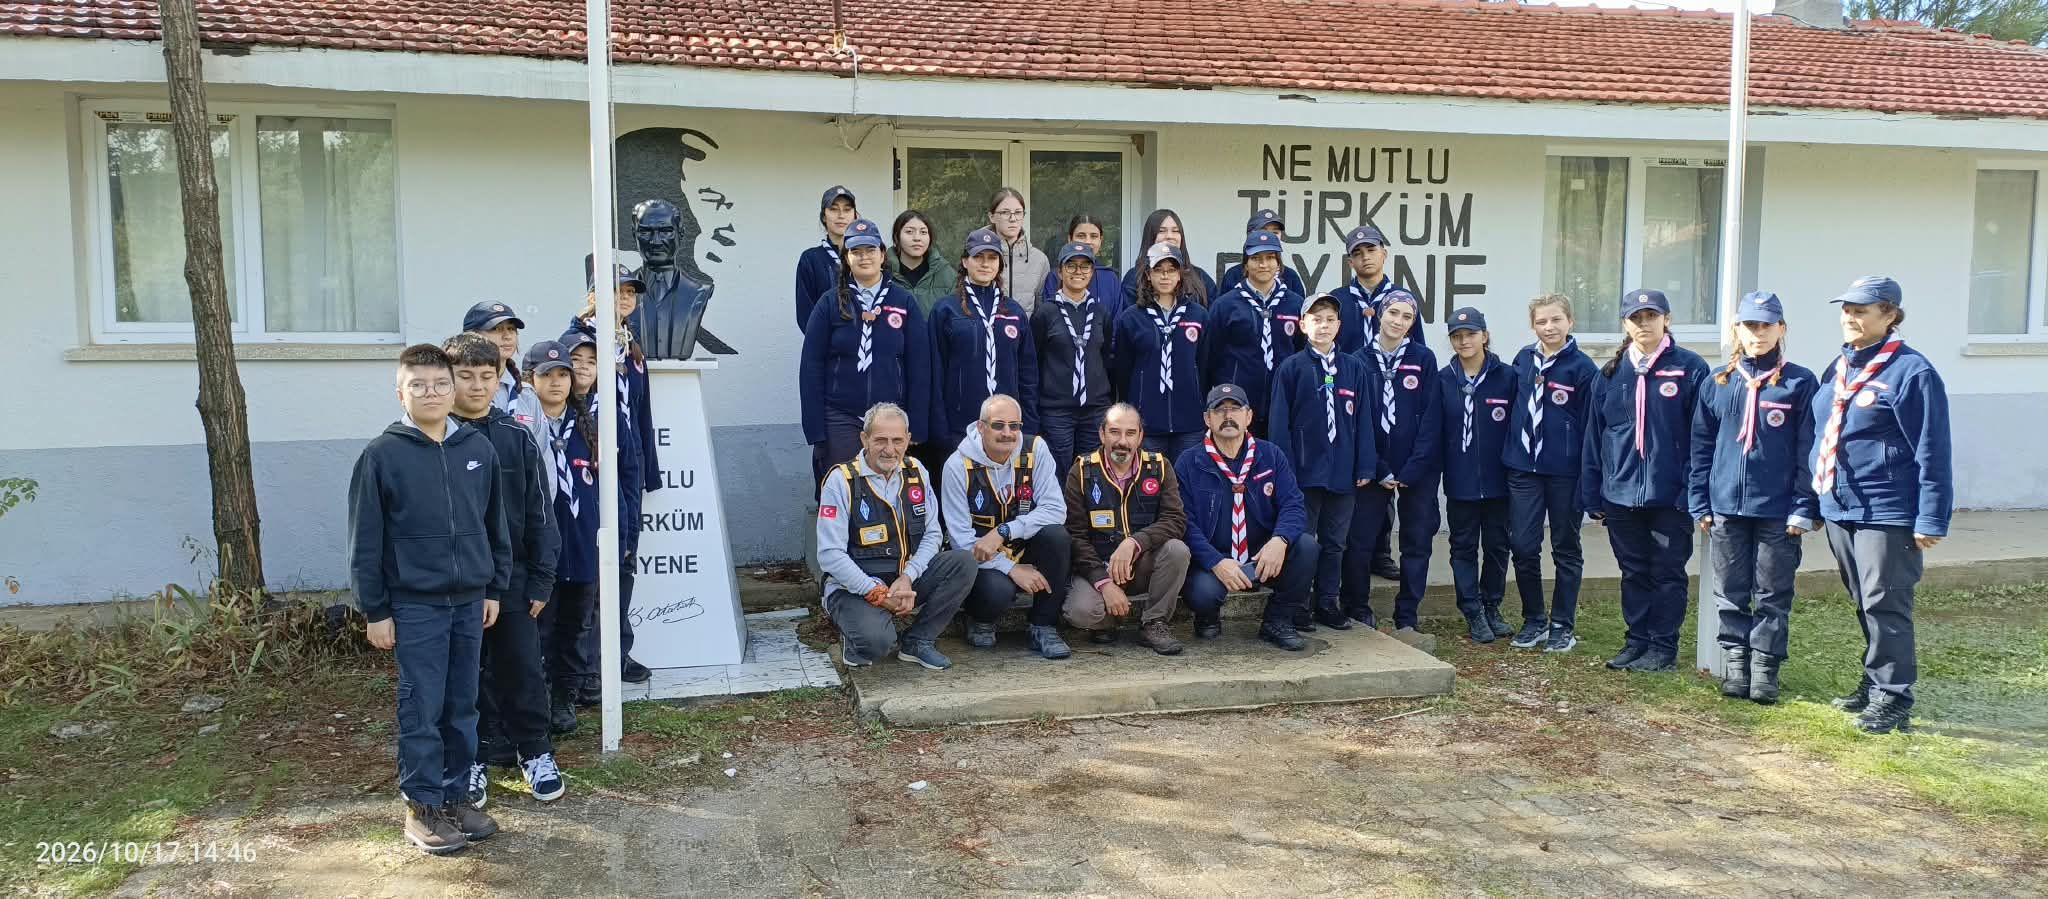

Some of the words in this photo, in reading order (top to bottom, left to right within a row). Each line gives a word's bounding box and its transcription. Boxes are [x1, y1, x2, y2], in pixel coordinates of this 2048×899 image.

[1262, 143, 1312, 182] NE
[1327, 145, 1450, 184] MUTLU
[1237, 189, 1473, 248] TÜRKÜM
[640, 508, 704, 532] RKÜM
